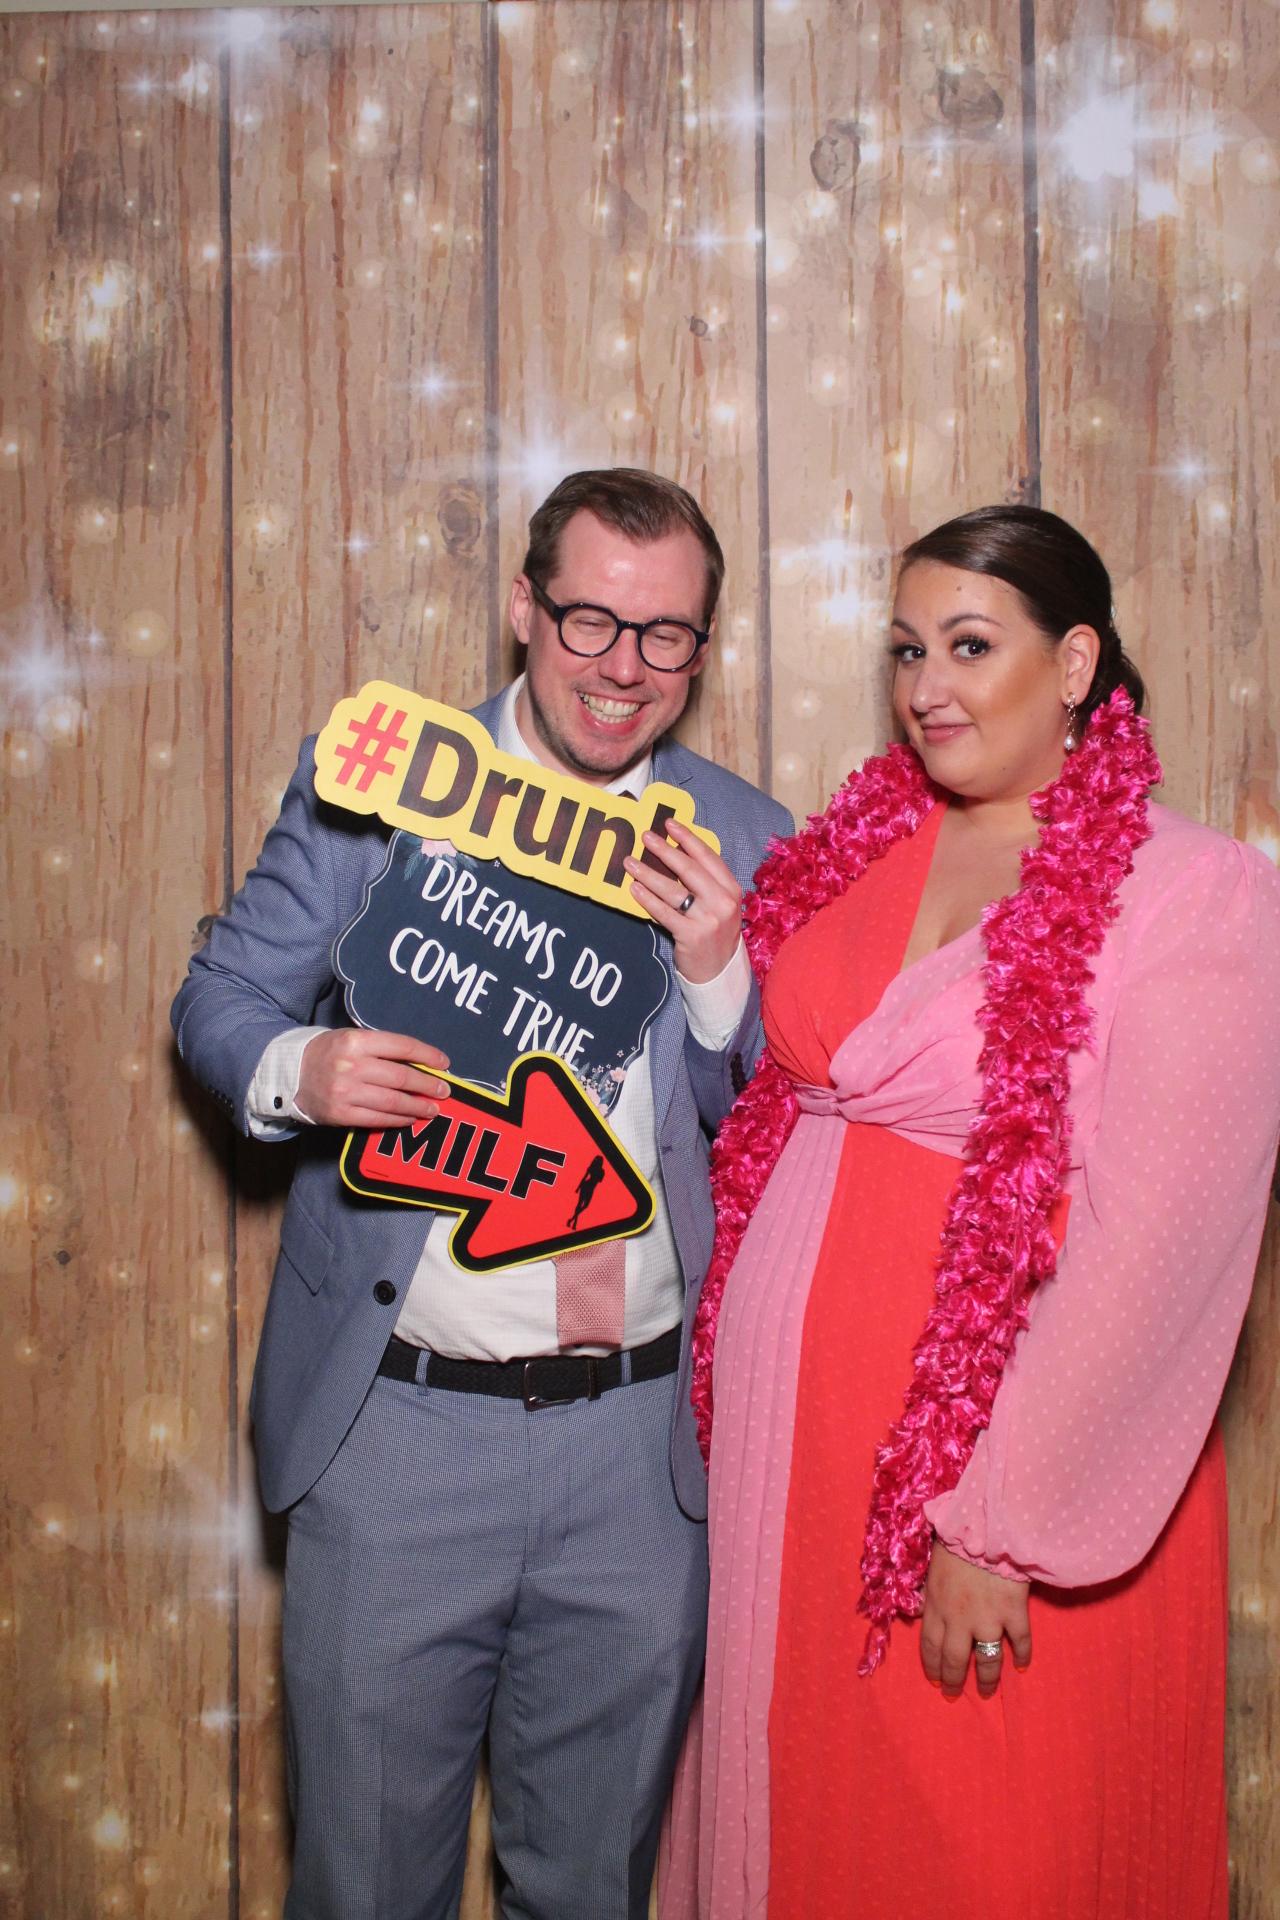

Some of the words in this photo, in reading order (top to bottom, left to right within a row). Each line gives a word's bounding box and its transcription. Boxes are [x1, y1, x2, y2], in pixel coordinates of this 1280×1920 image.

[389, 927, 498, 1015] COME
[502, 986, 595, 1072] TRUE
[421, 859, 566, 980] DREAMS
[569, 947, 622, 1007] DO
[376, 1114, 567, 1199] MILF
